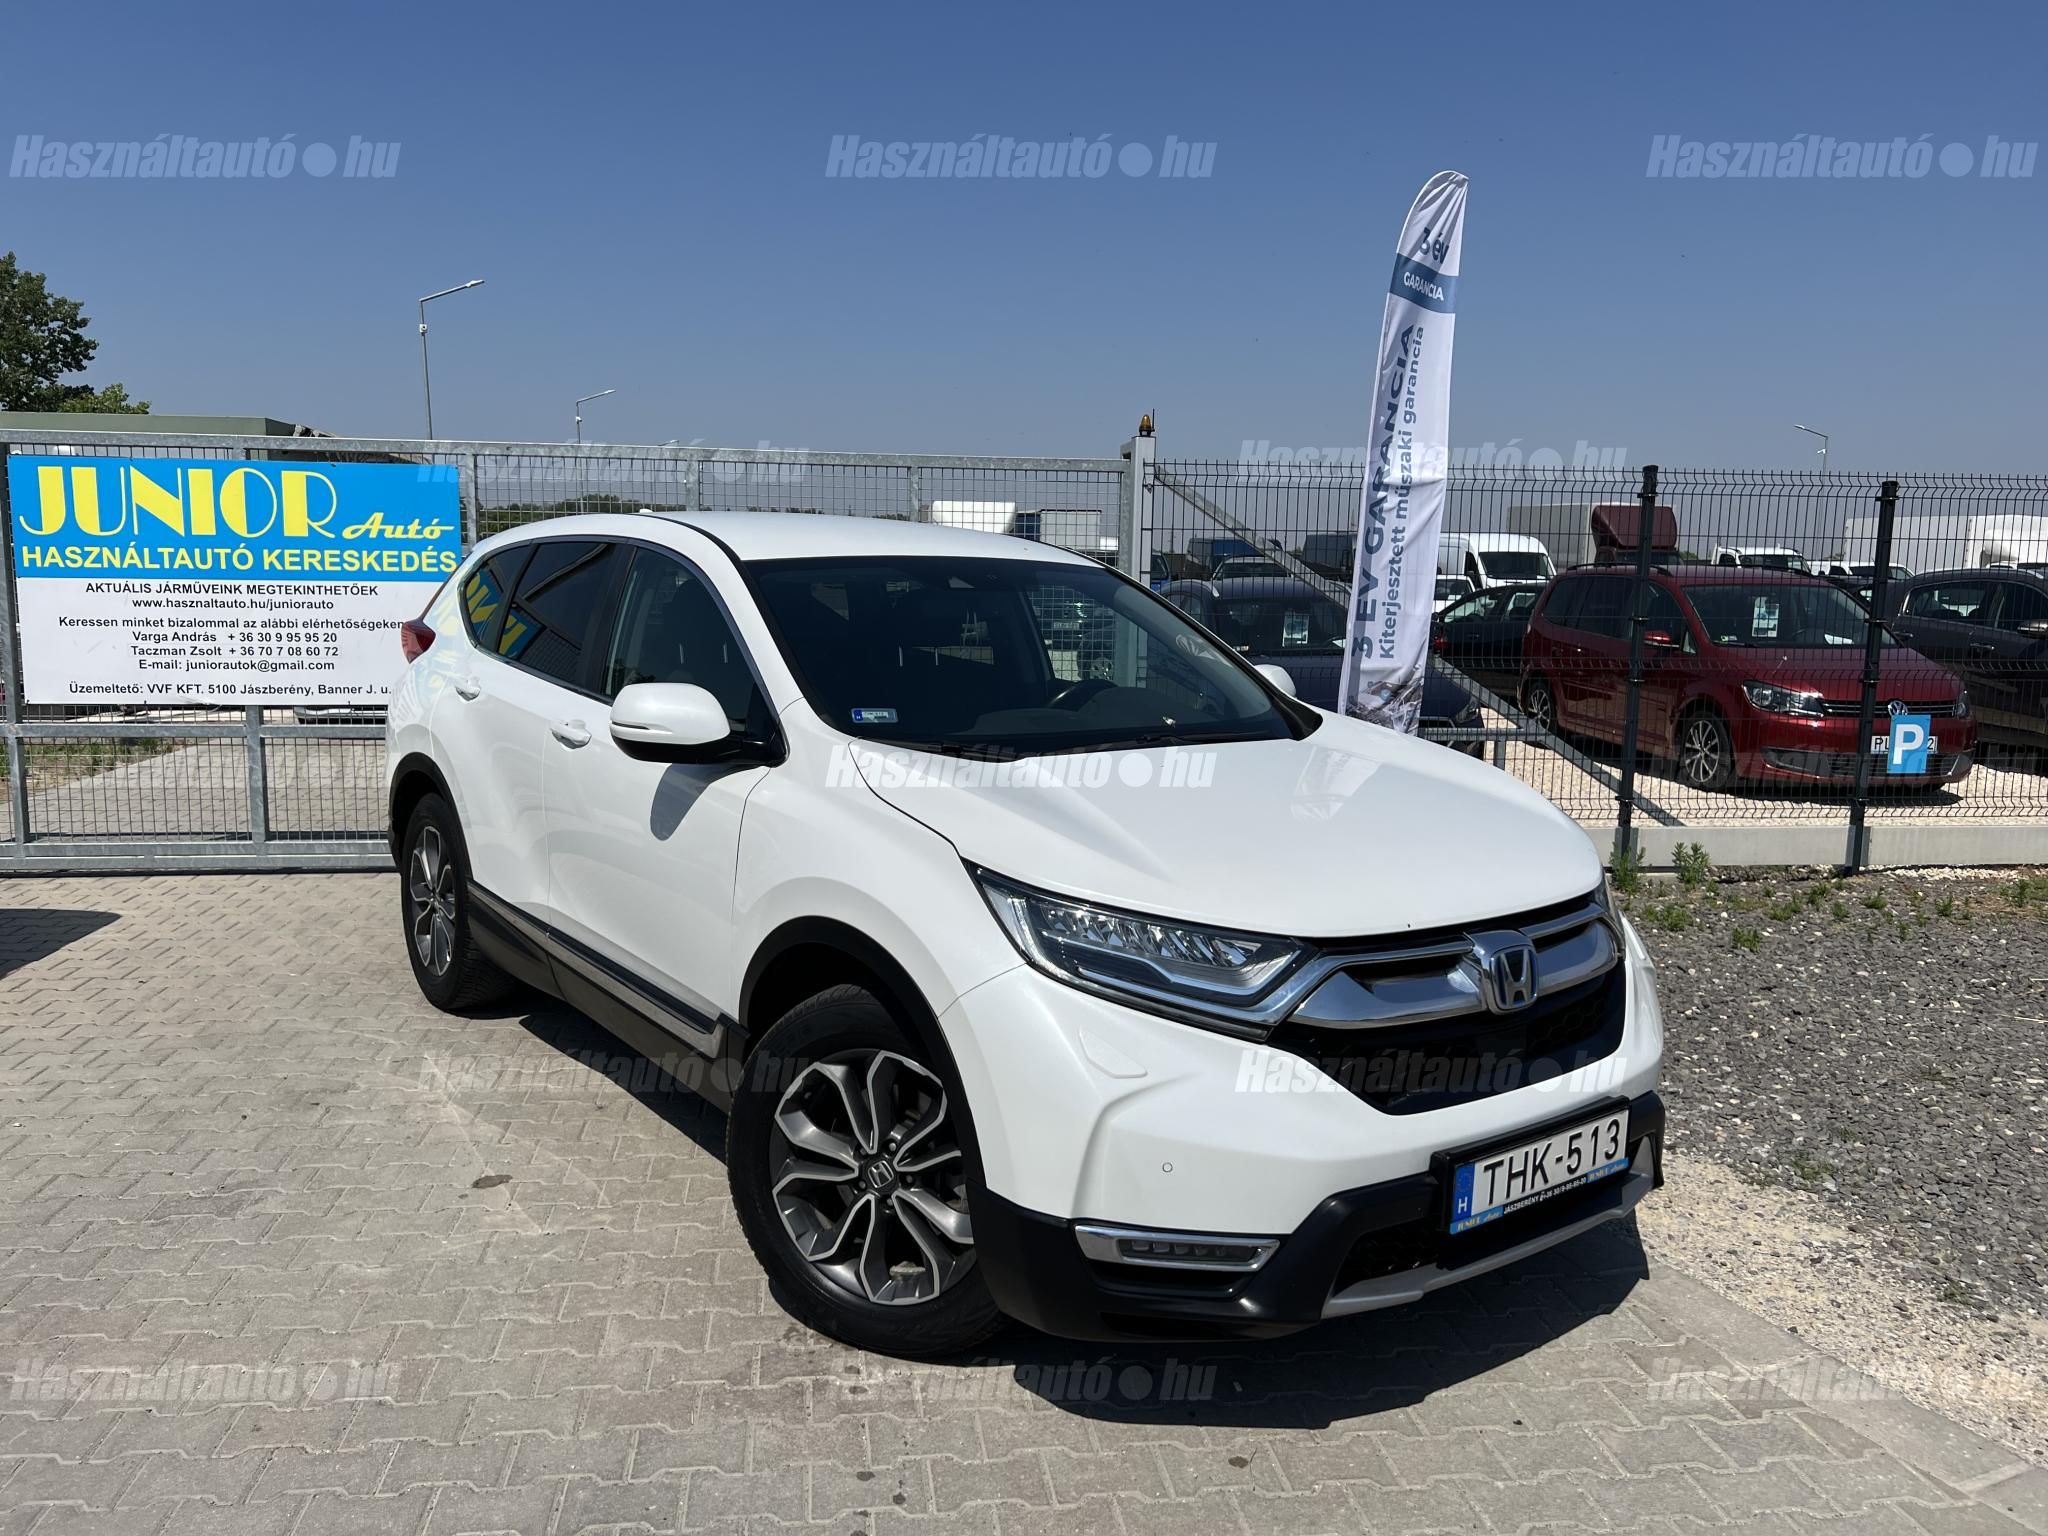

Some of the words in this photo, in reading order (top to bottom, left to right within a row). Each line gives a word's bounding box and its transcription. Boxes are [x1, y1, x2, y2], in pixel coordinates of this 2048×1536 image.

[1431, 232, 1450, 265] év
[1403, 271, 1445, 302] GARANCIA
[1402, 326, 1424, 425] garancia
[1393, 429, 1413, 520] műszaki
[19, 465, 336, 539] JUNIOR
[341, 511, 456, 540] Autó
[1351, 635, 1374, 660] 3
[1364, 323, 1415, 555] GARANCIA
[22, 542, 254, 571] HASZNÁLTAUTÓ
[262, 545, 458, 573] KERESKEDÉS
[85, 580, 152, 594] AKTUÁLIS
[155, 581, 243, 595] JÁRMŰVEINK
[246, 582, 379, 596] MEGTEKINTHETŐEK
[1378, 525, 1406, 660] Kiterjesztett
[131, 597, 334, 612] www.hasznaltauto.hu/juniorauto
[59, 616, 118, 628] Keressen
[122, 617, 165, 628] minket
[167, 617, 239, 628] bizalommal
[243, 620, 257, 629] az
[260, 618, 299, 629] alábbi
[132, 631, 169, 644] Varga
[171, 631, 217, 642] András
[227, 633, 236, 641] +
[239, 632, 254, 643] 36
[257, 632, 272, 643] 30
[275, 632, 283, 643] 9
[286, 632, 302, 643] 95
[304, 632, 320, 643] 95
[322, 632, 338, 643] 20
[130, 645, 187, 656] Taczman
[189, 645, 222, 656] Zsolt
[228, 647, 237, 655] +
[240, 646, 255, 656] 36
[257, 646, 273, 656] 70
[276, 646, 284, 657] 7
[287, 646, 302, 657] 08
[305, 646, 321, 657] 60
[323, 646, 339, 657] 72
[138, 659, 182, 670] E-mail:
[185, 659, 335, 673] juniorautok@gmail.com
[69, 681, 144, 694] Üzemeltető:
[146, 683, 173, 694] VVF
[176, 683, 204, 694] KFT.
[207, 684, 237, 694] 5100
[239, 684, 314, 697] Jászberény,
[317, 684, 363, 695] Banner
[365, 684, 377, 695] J.
[380, 686, 392, 695] u.
[1892, 723, 1925, 765] P
[1483, 1118, 1620, 1206] THK-513
[1457, 1196, 1468, 1214] H
